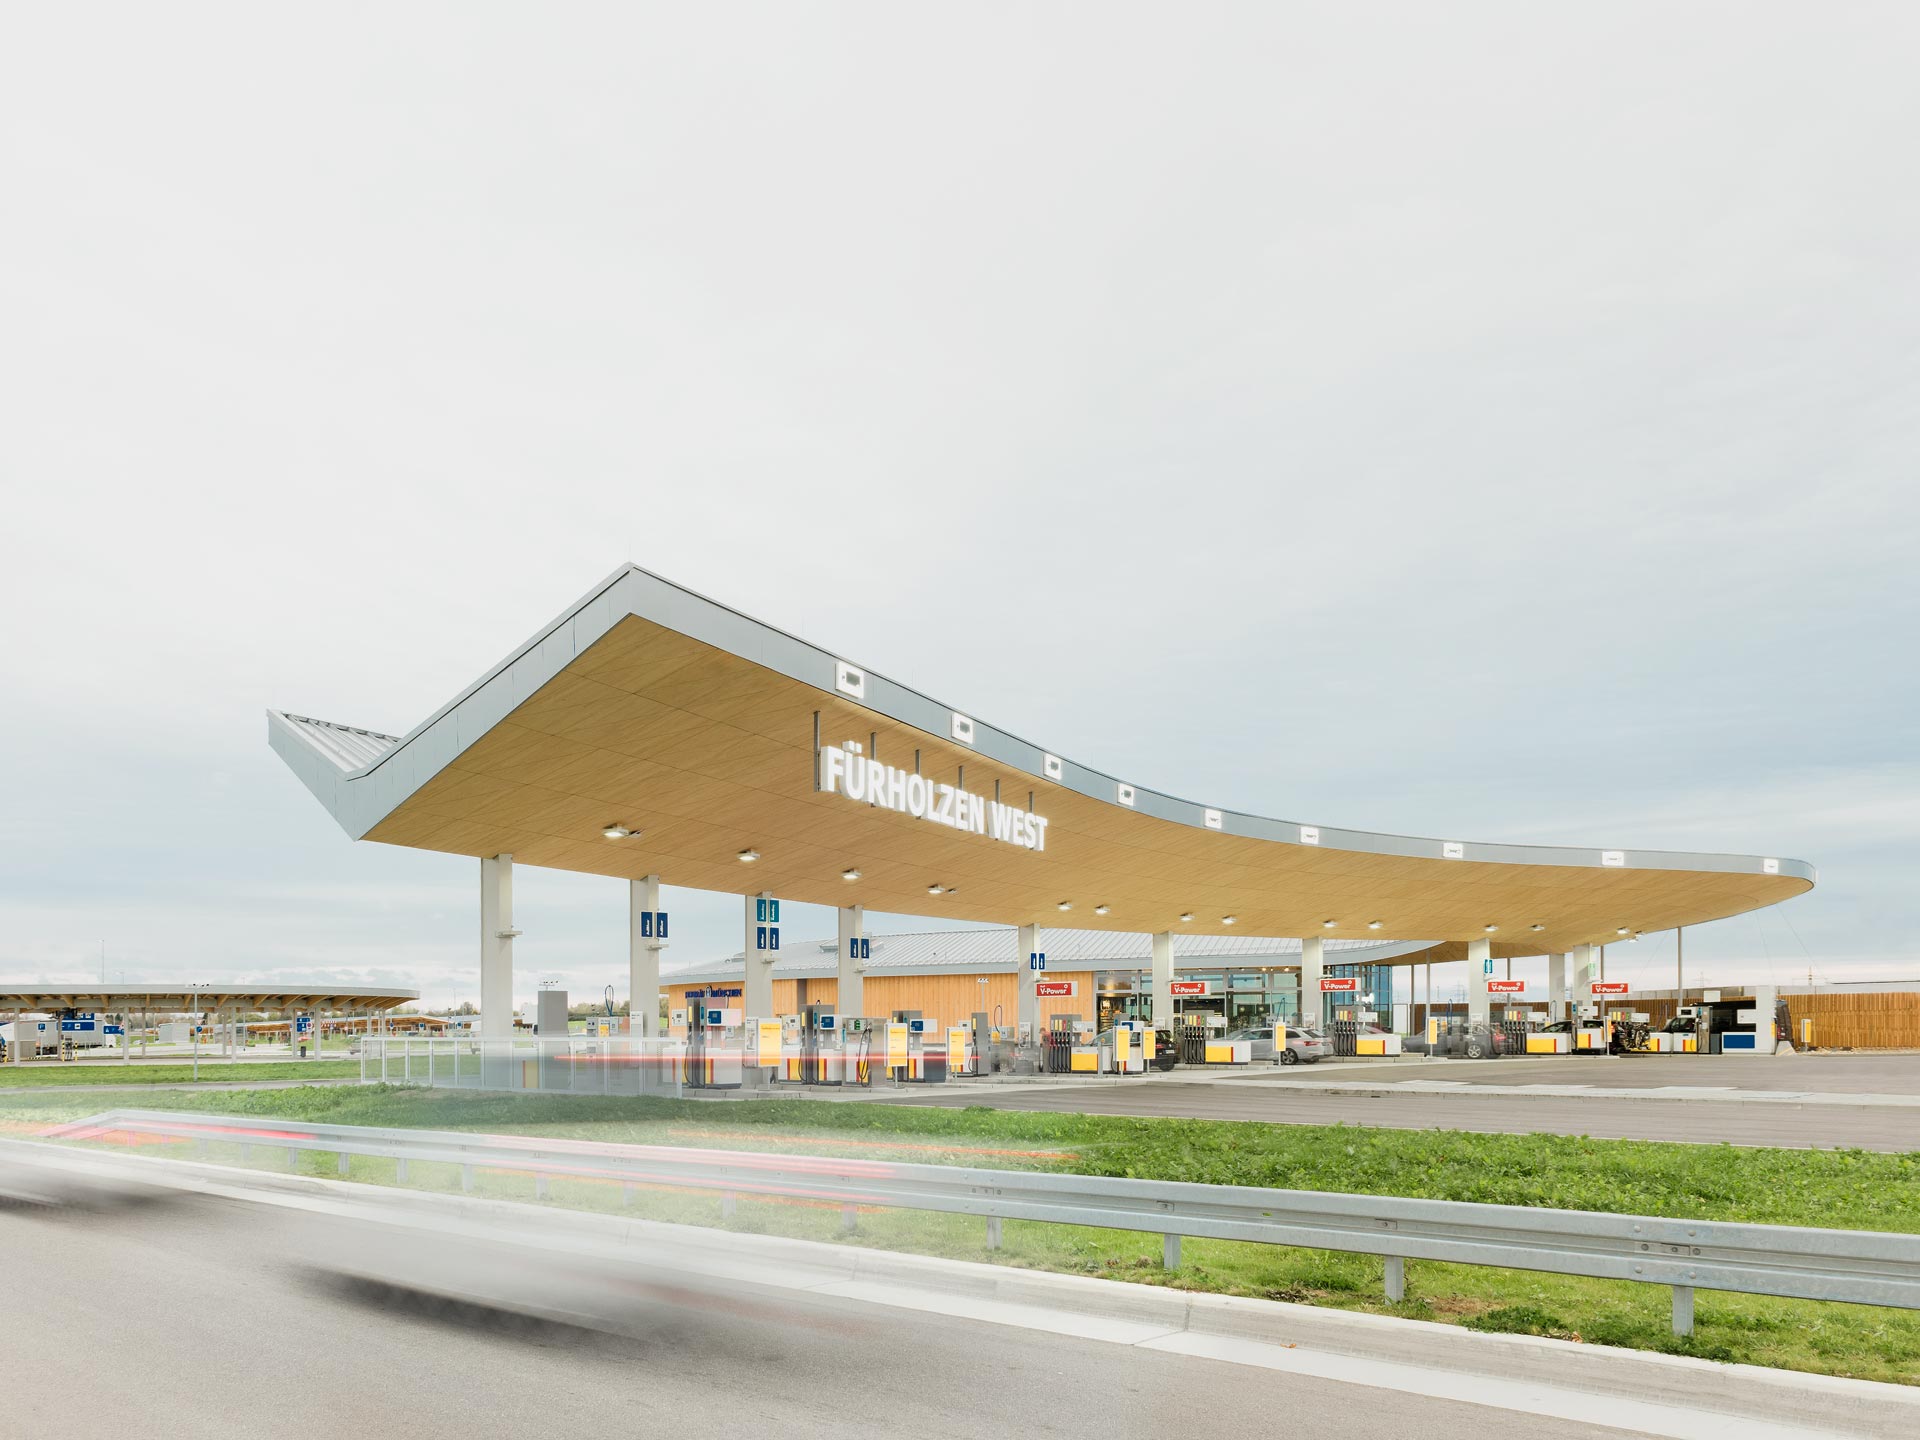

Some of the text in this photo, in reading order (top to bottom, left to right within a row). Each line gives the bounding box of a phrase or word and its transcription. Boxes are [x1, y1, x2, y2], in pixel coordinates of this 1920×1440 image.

[821, 740, 1048, 851] FÜRHOLZEN WEST
[1040, 987, 1067, 995] V-Power
